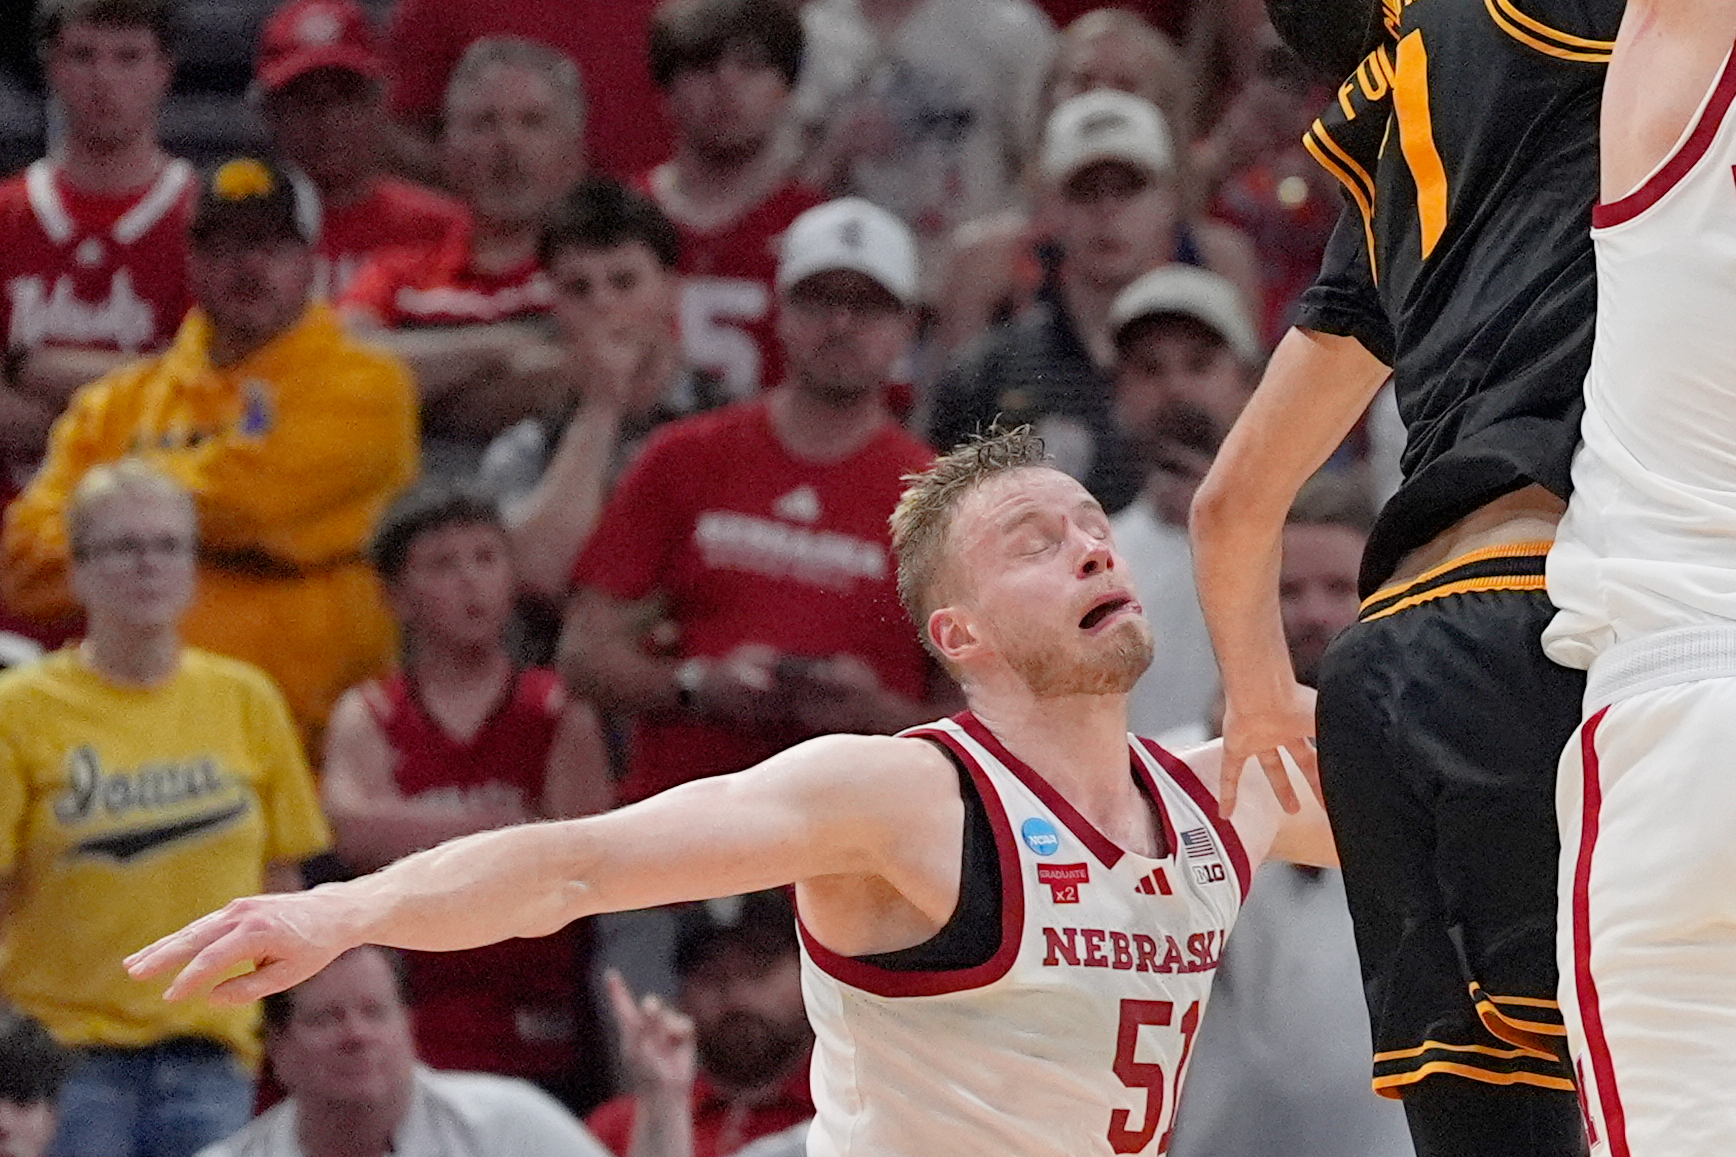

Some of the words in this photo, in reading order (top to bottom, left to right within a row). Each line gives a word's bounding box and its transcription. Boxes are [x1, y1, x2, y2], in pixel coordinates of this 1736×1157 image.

[1055, 886, 1076, 901] x2
[1042, 927, 1225, 974] NEBRASK
[1107, 998, 1200, 1157] 51
